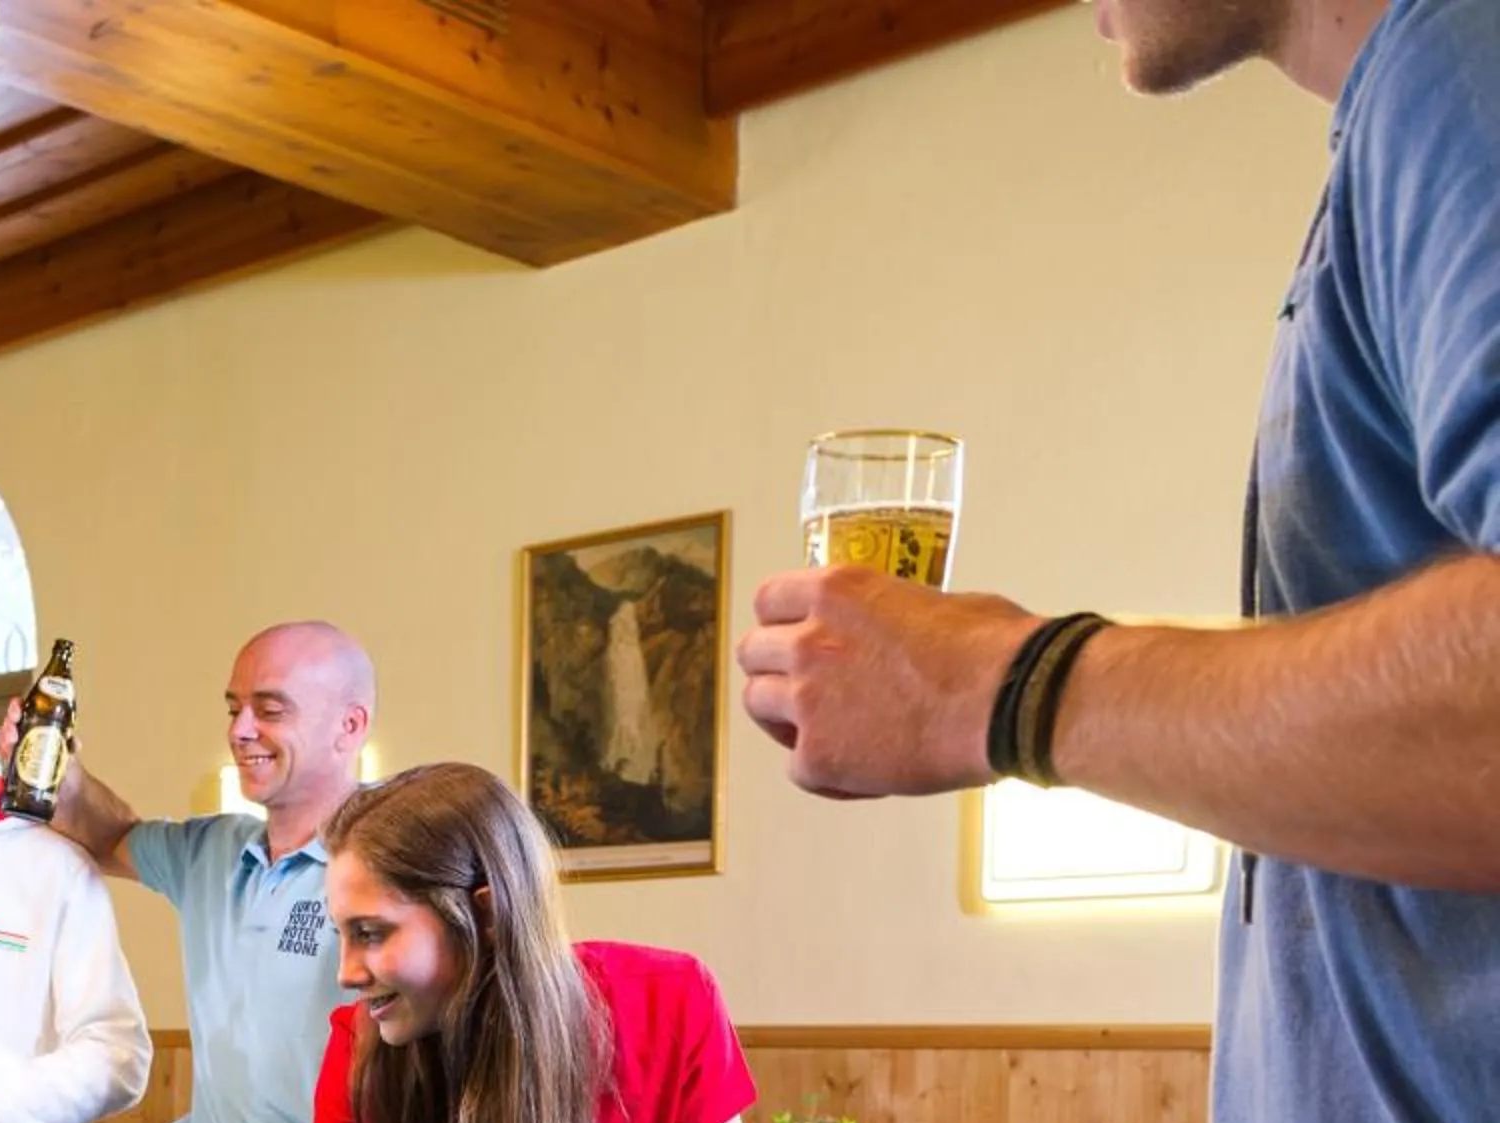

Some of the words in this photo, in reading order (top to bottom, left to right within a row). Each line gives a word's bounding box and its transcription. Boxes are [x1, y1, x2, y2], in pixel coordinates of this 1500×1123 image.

[291, 900, 322, 913] EURO
[289, 912, 326, 929] YOUTH
[281, 926, 316, 942] HOTEL
[277, 940, 320, 957] KRONE
